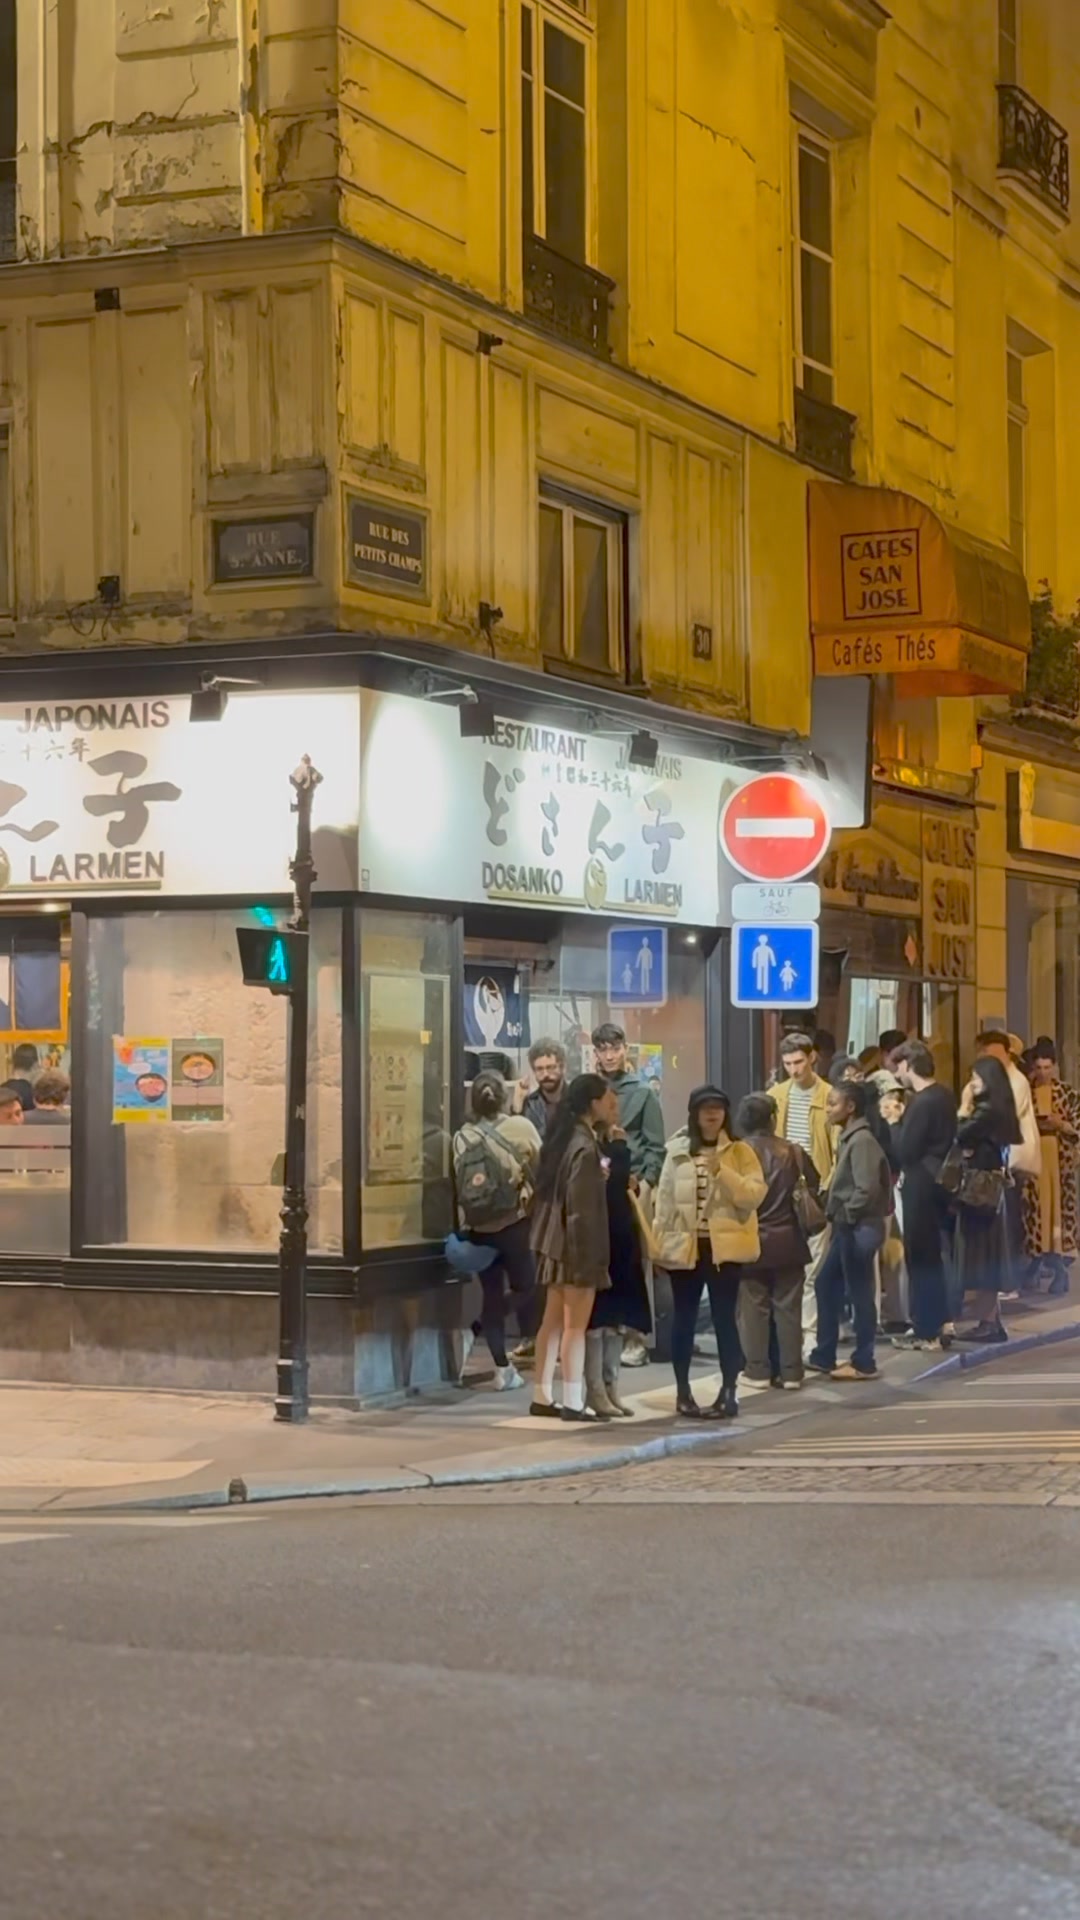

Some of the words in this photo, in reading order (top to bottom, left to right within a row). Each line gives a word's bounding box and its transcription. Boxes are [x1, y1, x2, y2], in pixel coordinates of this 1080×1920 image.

[246, 530, 281, 547] RUE
[369, 521, 390, 540] RUE
[391, 528, 410, 546] DES
[354, 543, 387, 565] PETITS
[388, 551, 422, 574] CHAMPS
[859, 564, 903, 586] SAN
[857, 588, 909, 611] JOSE
[832, 635, 883, 666] Cafés
[895, 632, 936, 661] Thés
[17, 700, 170, 734] JAPONAIS
[30, 851, 165, 882] LARMEN
[482, 861, 563, 895] DOSANKO
[624, 878, 682, 907] LARMEN
[759, 888, 793, 898] SAUF
